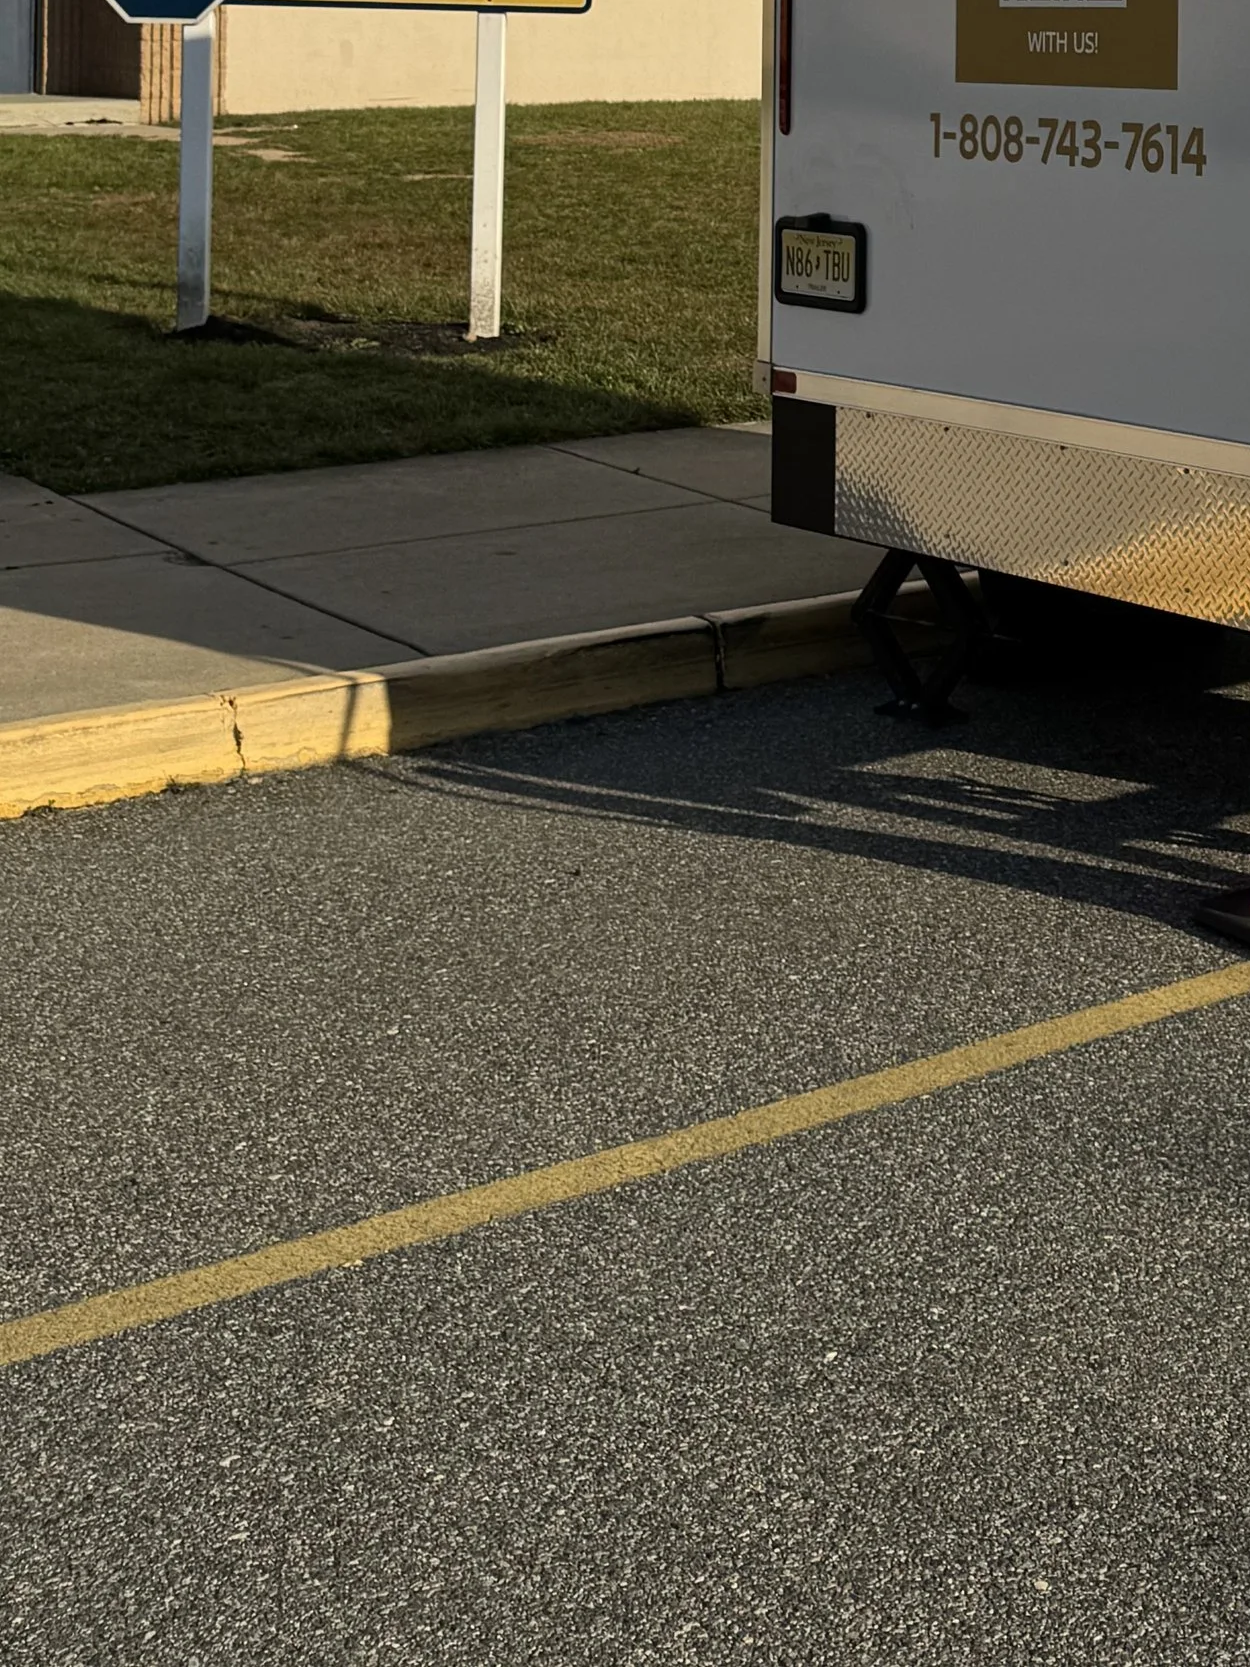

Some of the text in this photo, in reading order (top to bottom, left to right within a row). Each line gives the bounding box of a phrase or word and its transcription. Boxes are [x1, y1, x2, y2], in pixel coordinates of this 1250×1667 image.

[1028, 31, 1098, 54] WITH US!
[930, 113, 1207, 176] 1-808-743-7614
